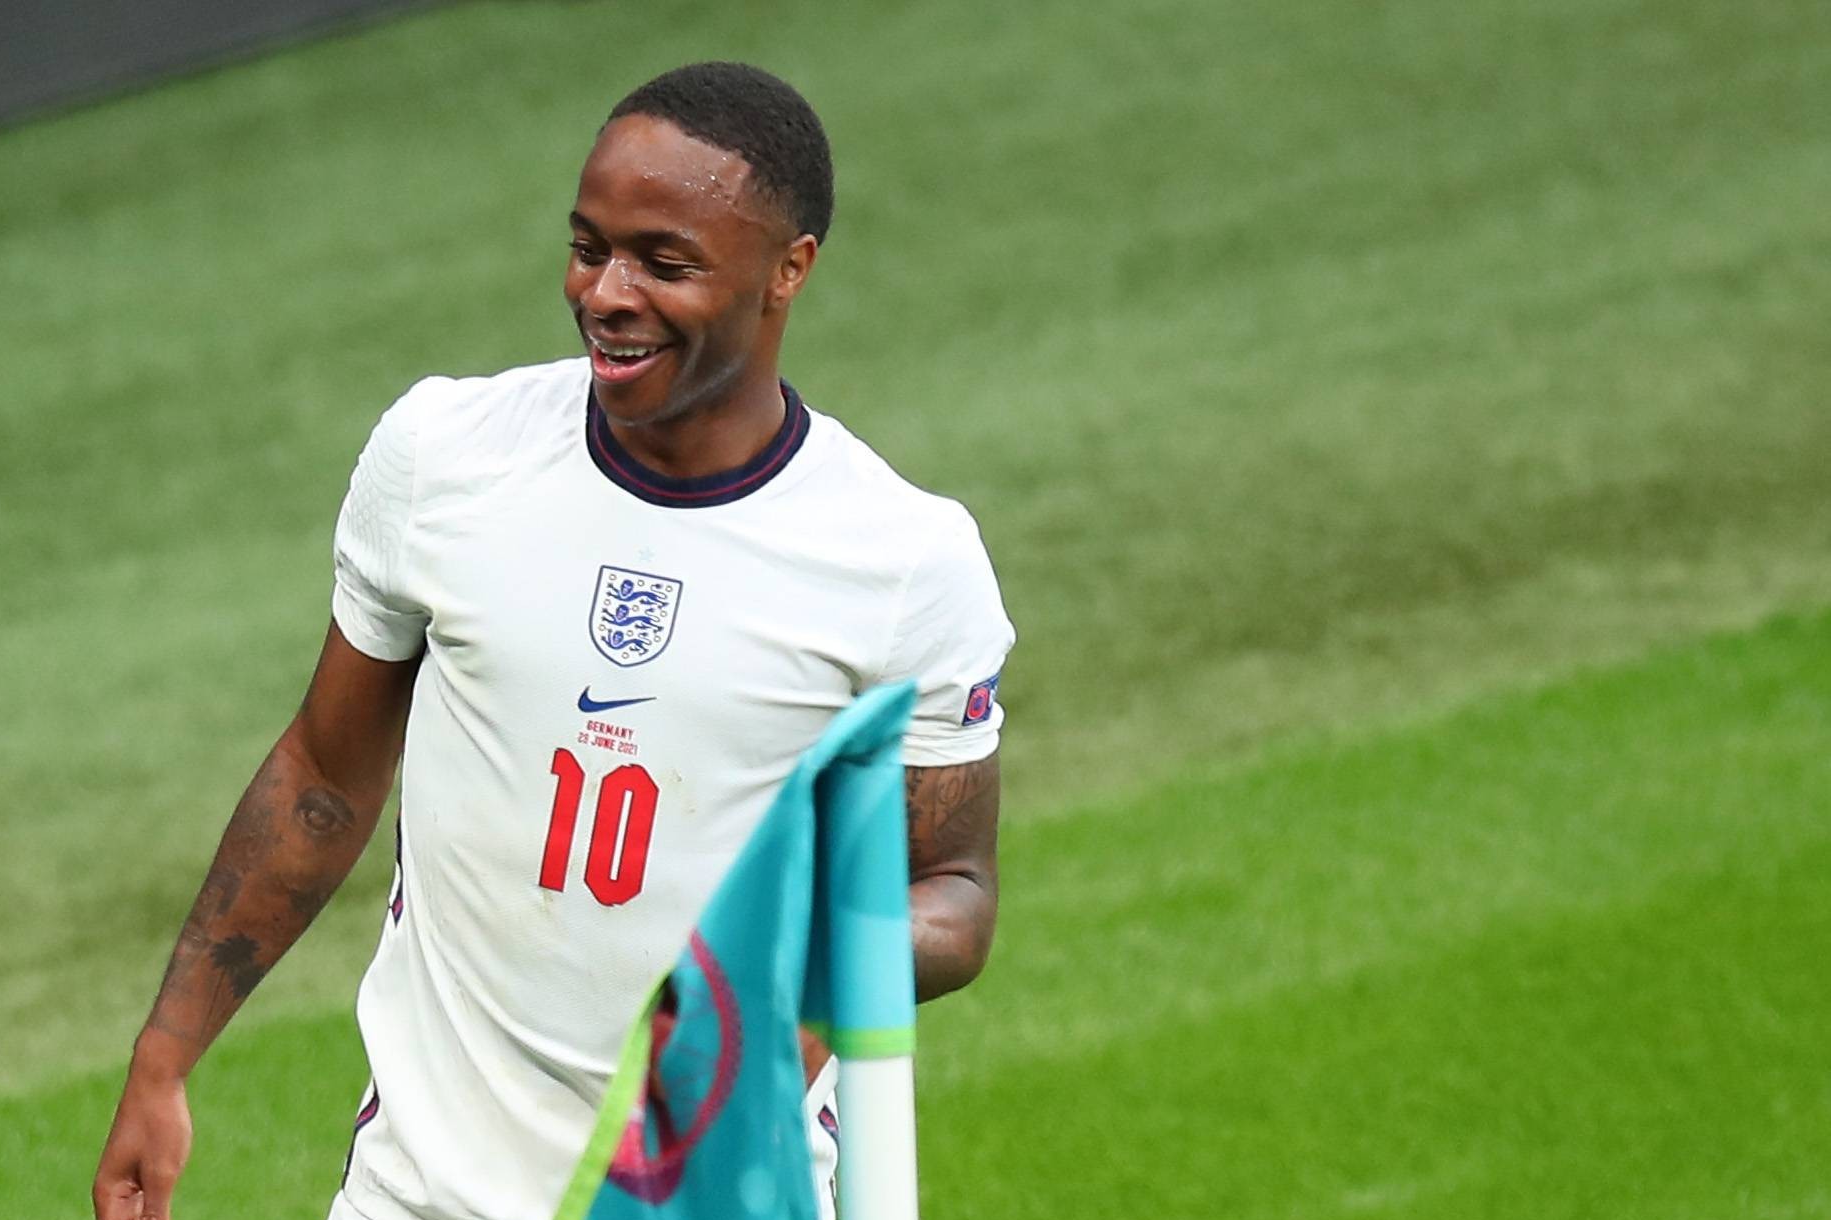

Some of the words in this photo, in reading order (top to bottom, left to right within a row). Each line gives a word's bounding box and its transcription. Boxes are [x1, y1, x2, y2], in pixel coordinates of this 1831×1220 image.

[587, 720, 633, 740] GERMANY
[591, 736, 615, 750] JUNE
[617, 741, 638, 756] 2021
[539, 747, 660, 907] 10
